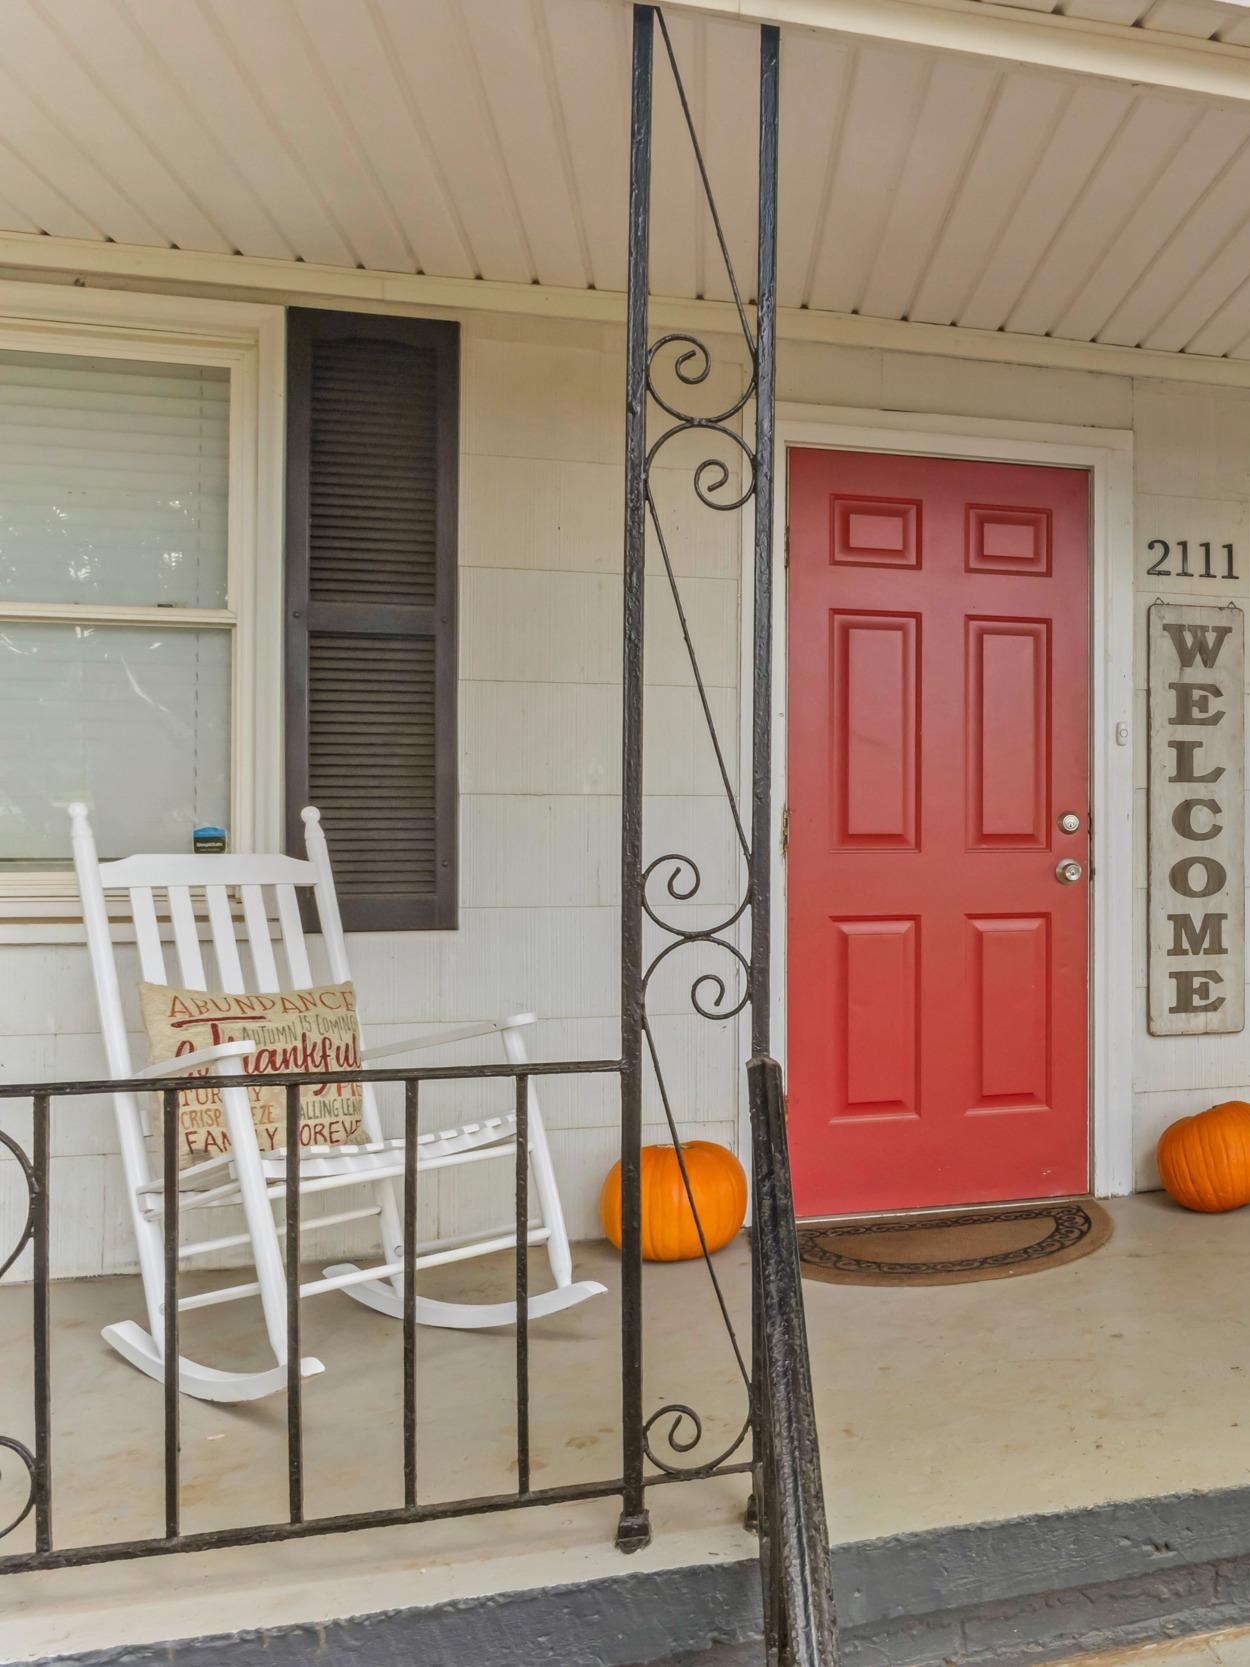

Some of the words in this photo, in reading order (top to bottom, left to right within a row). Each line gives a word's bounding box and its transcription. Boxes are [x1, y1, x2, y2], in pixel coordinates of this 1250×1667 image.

[1147, 539, 1240, 579] 2111
[1163, 623, 1233, 1014] WELCOME
[168, 991, 355, 1018] ABUNDANCE
[242, 1021, 297, 1047] AUTUMN
[299, 1014, 312, 1032] IS
[172, 1016, 361, 1078] Tankful
[179, 1088, 261, 1107] TURY
[300, 1098, 339, 1120] ALLING
[180, 1108, 222, 1130] CRISP
